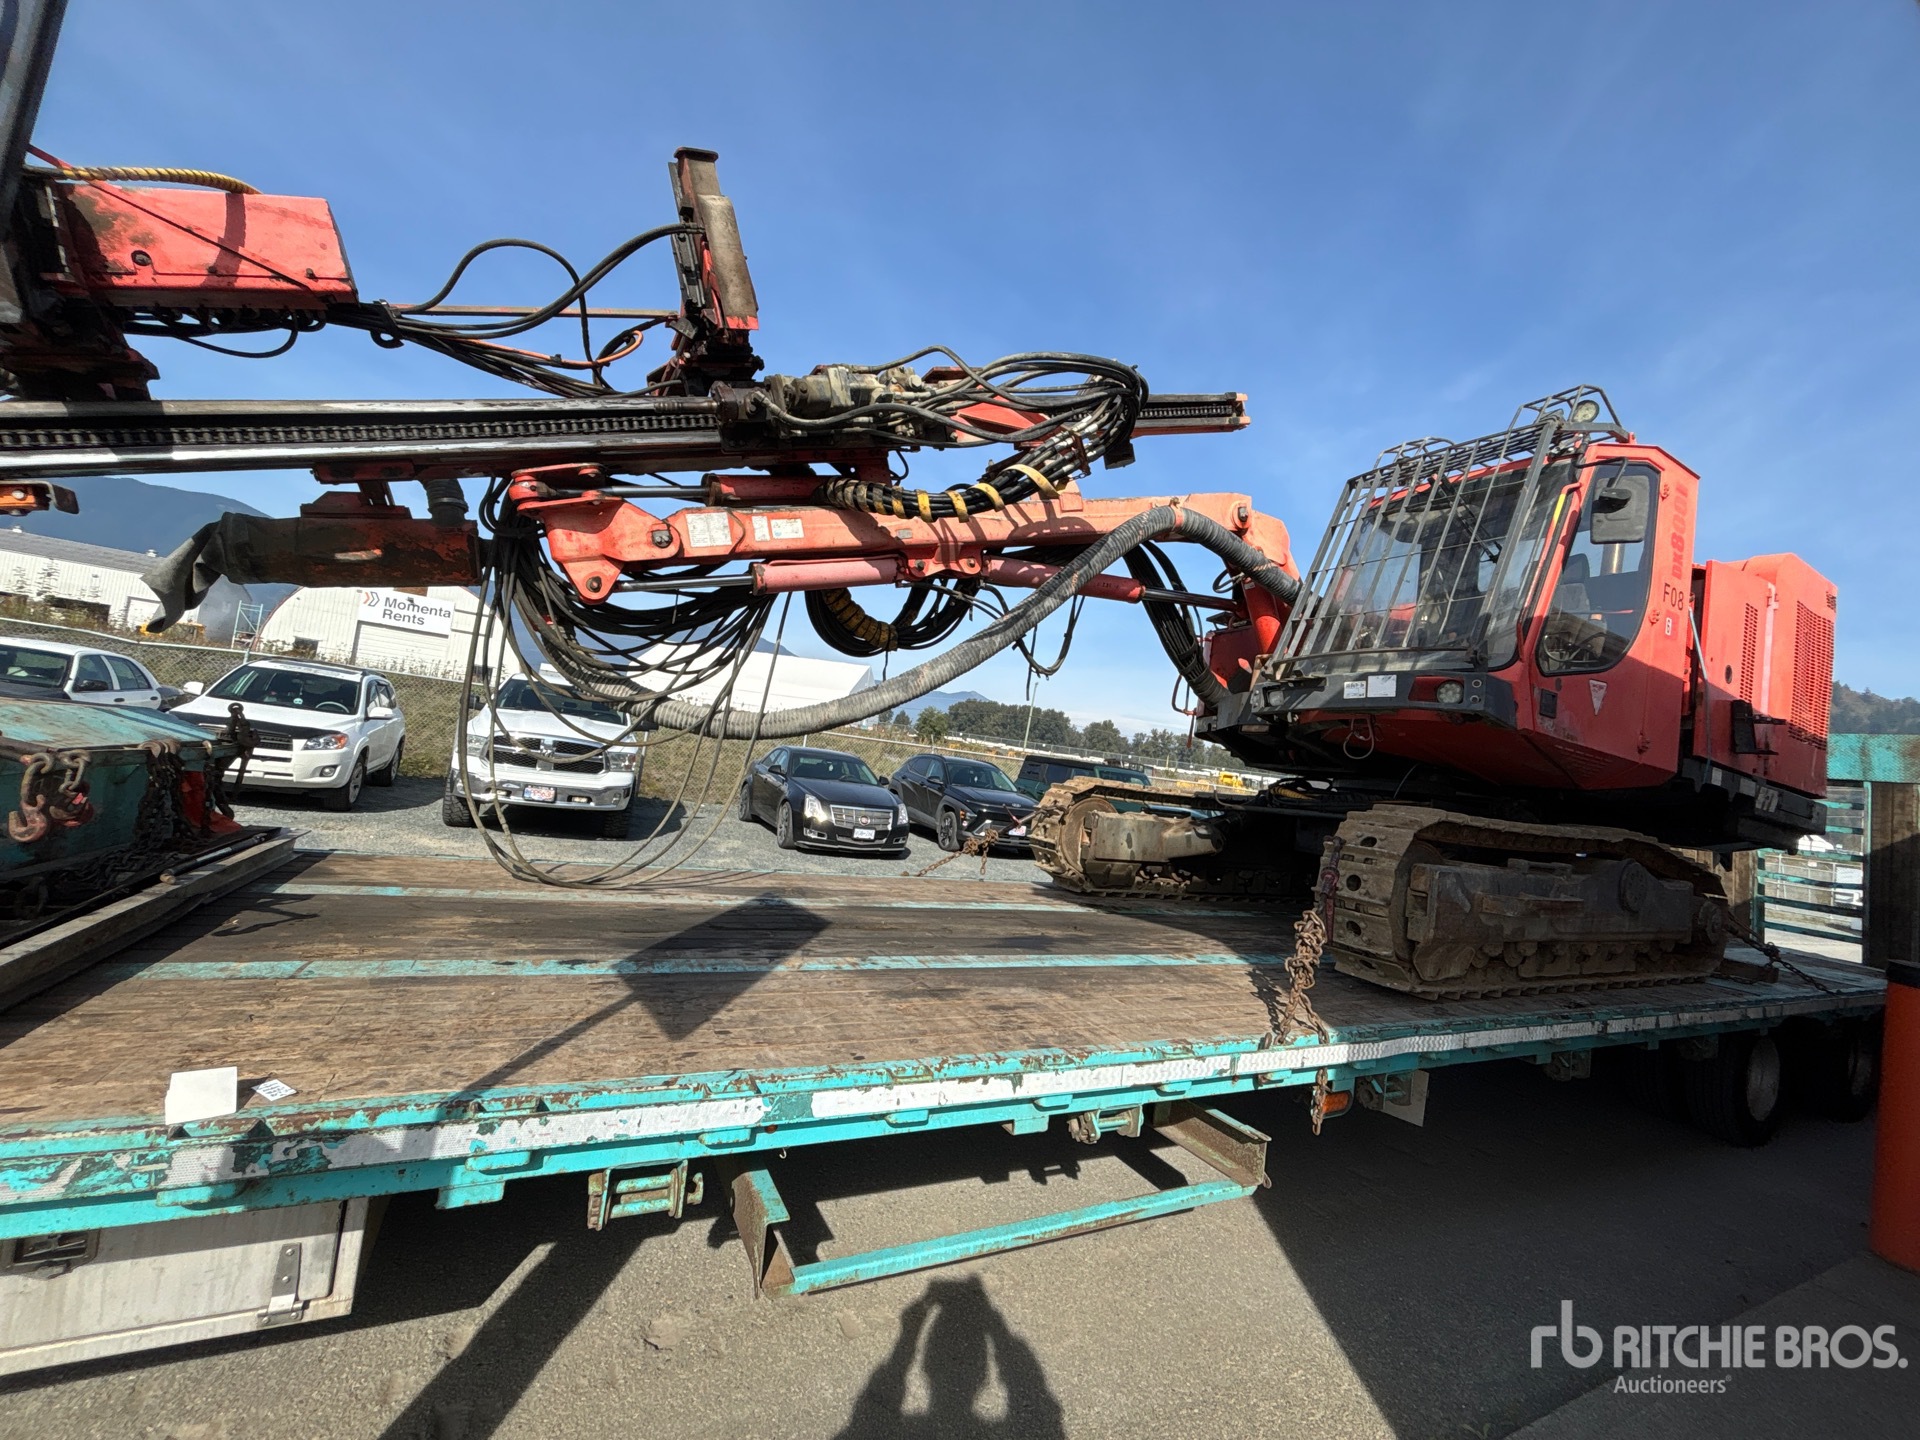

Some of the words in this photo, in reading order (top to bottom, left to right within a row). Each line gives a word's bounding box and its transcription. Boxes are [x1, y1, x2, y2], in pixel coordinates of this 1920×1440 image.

[384, 596, 451, 619] Momenta
[1663, 582, 1684, 611] F08
[382, 608, 425, 626] Rents
